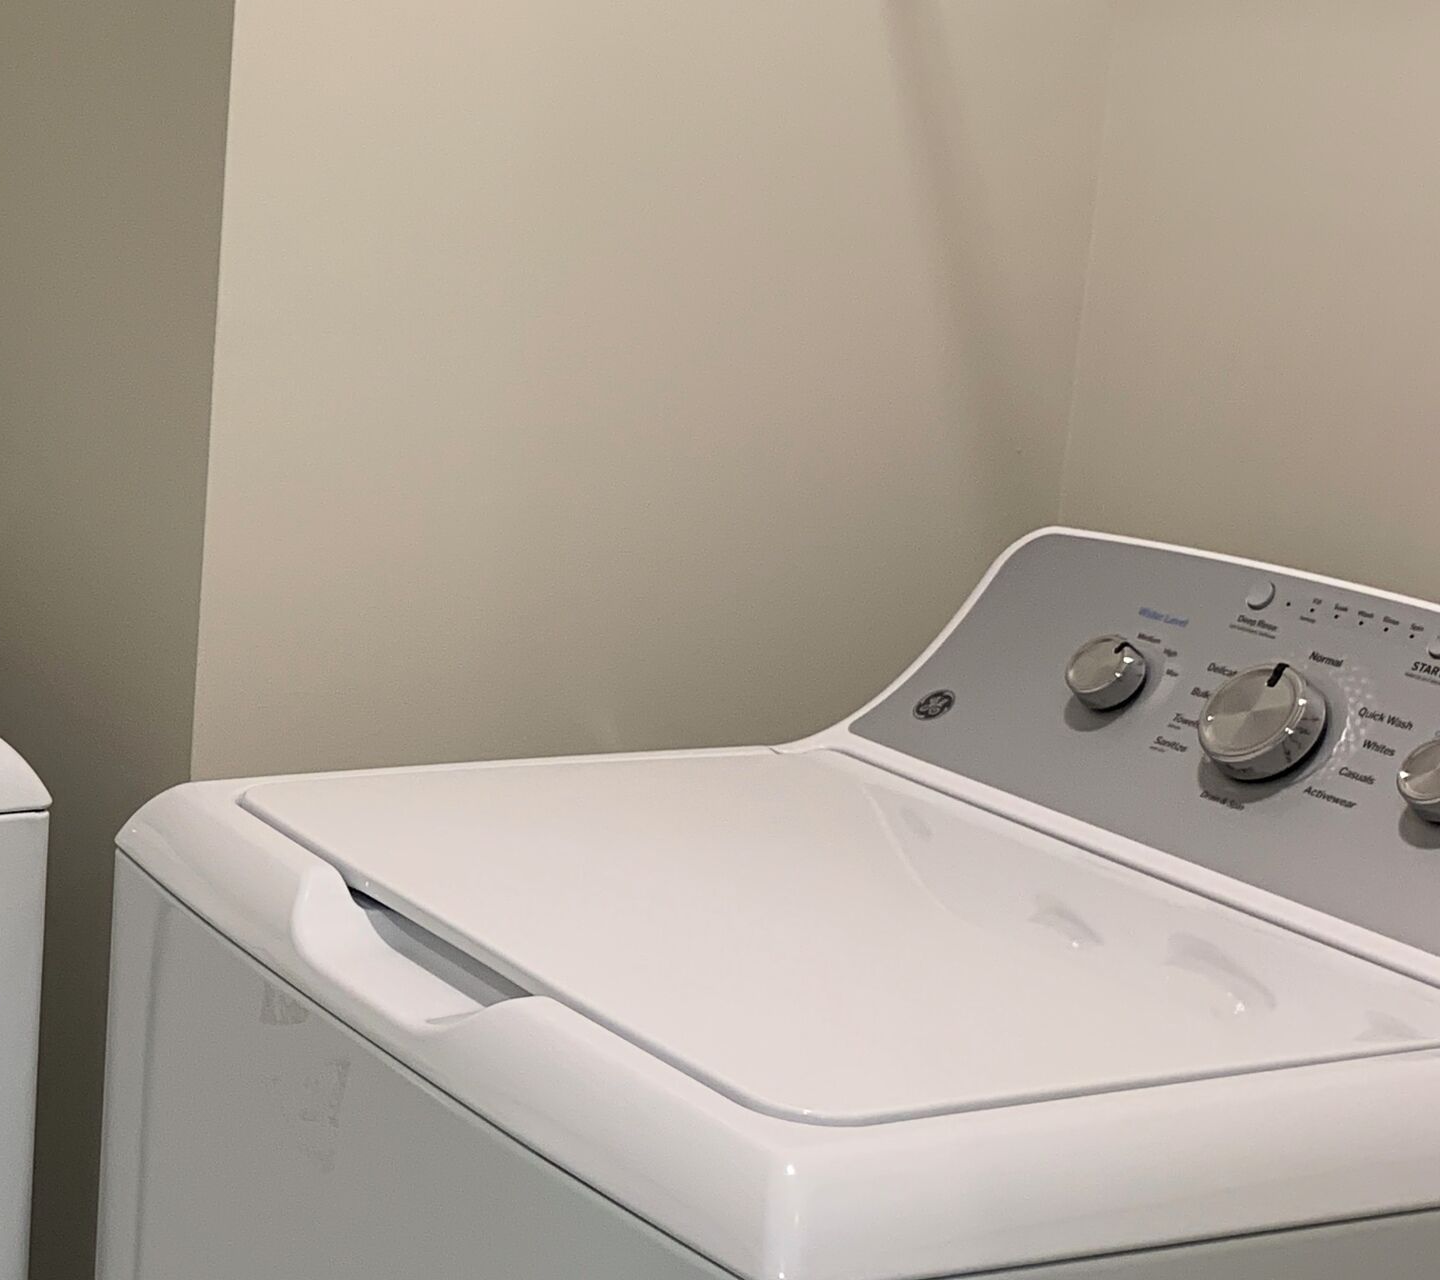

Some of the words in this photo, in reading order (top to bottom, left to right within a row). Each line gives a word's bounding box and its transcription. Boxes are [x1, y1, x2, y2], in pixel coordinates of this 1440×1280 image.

[1308, 650, 1344, 668] Normal
[1410, 661, 1440, 680] STAR
[1358, 706, 1385, 722] Quick
[1386, 714, 1414, 731] Wash
[1362, 738, 1396, 757] Whites
[1338, 766, 1376, 786] Casuals
[1303, 785, 1357, 809] Activewear
